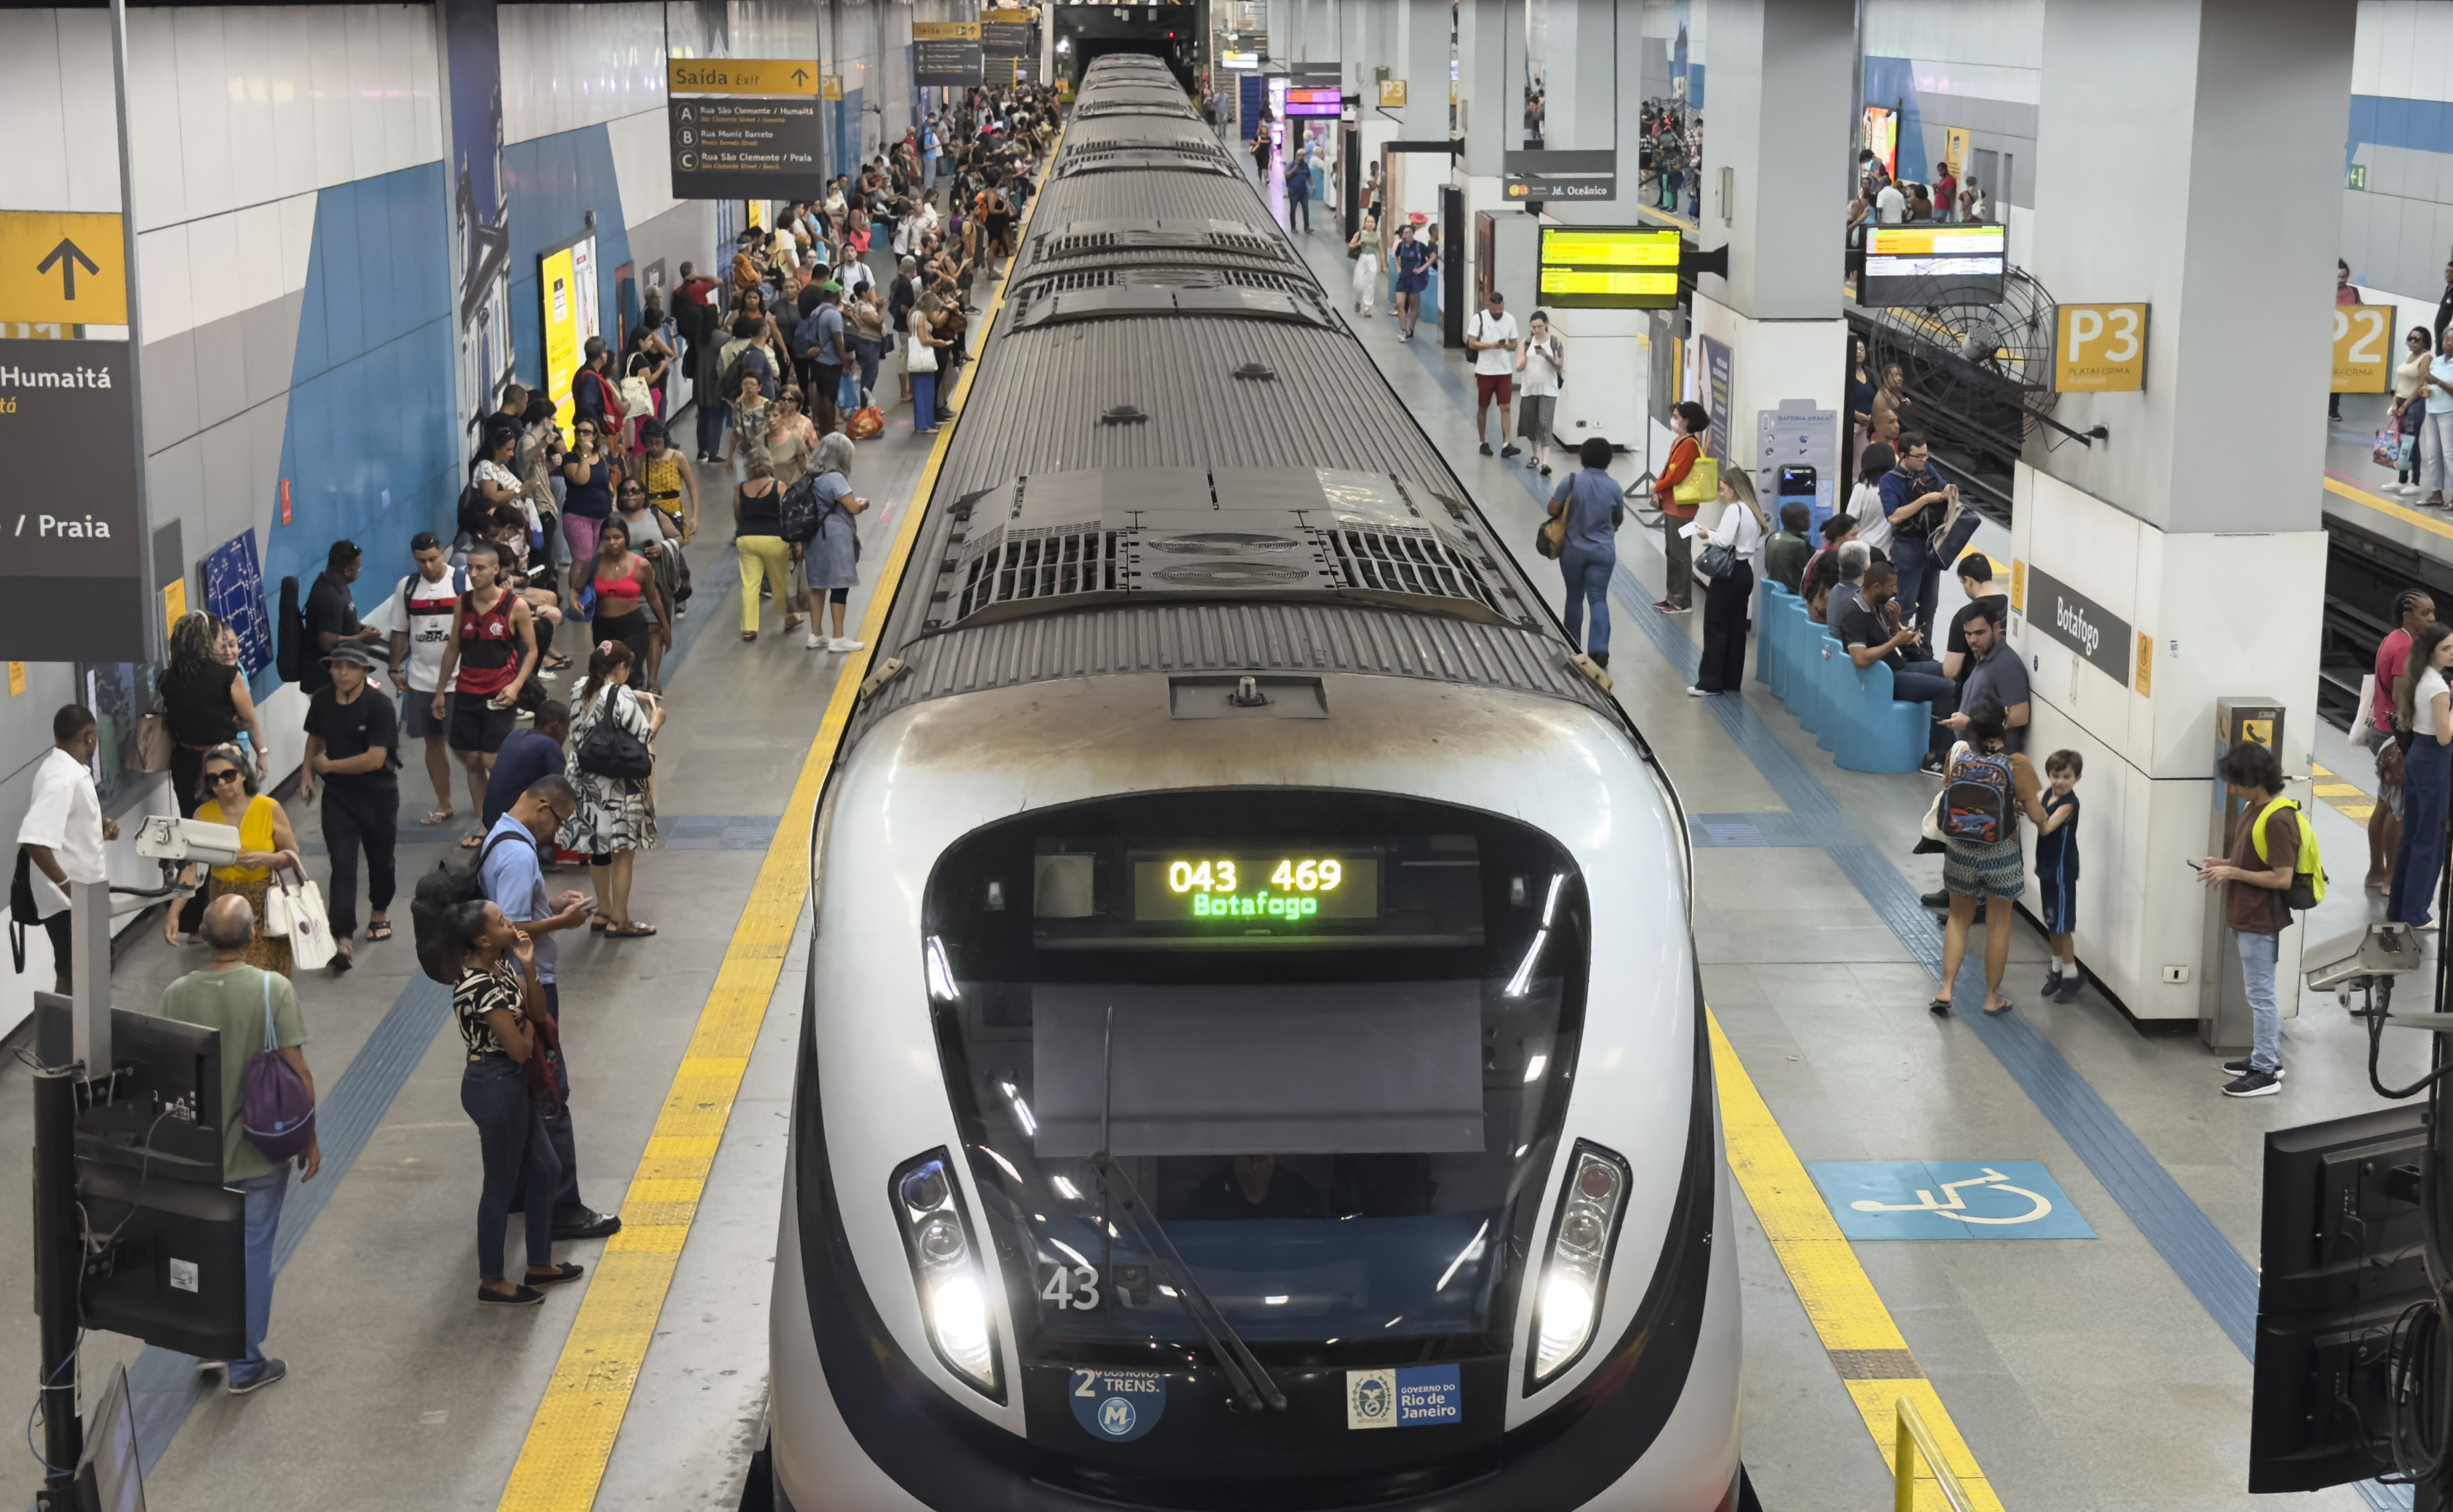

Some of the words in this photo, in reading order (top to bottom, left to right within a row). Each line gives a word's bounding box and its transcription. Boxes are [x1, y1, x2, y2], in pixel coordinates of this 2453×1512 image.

[676, 67, 728, 85] Saída
[736, 74, 759, 86] Exit
[1383, 80, 1403, 97] P3
[681, 107, 693, 121] A
[734, 107, 771, 115] Clemente
[780, 107, 813, 116] Humaitá
[683, 131, 693, 145] B
[682, 154, 693, 168] C
[702, 153, 718, 161] Rua
[721, 153, 736, 161] São
[739, 153, 779, 162] Clemente
[790, 153, 812, 163] Praia
[1551, 186, 1564, 196] Jd.
[1567, 185, 1608, 196] Oceânico
[2069, 308, 2139, 363] P3
[0, 366, 112, 388] Humaitá
[2067, 367, 2131, 376] PLATAFORMA
[39, 514, 111, 538] Praia
[2057, 595, 2099, 657] Botafogo
[1169, 860, 1237, 893] 043
[1270, 859, 1342, 891] 469
[1193, 891, 1318, 921] Botafogo
[1041, 1266, 1100, 1311] 43
[1103, 1378, 1161, 1393] TRENS.
[1400, 1384, 1441, 1393] GOVERNO
[1401, 1394, 1425, 1407] Rio
[1427, 1393, 1446, 1405] de
[1402, 1405, 1456, 1419] Janeiro
